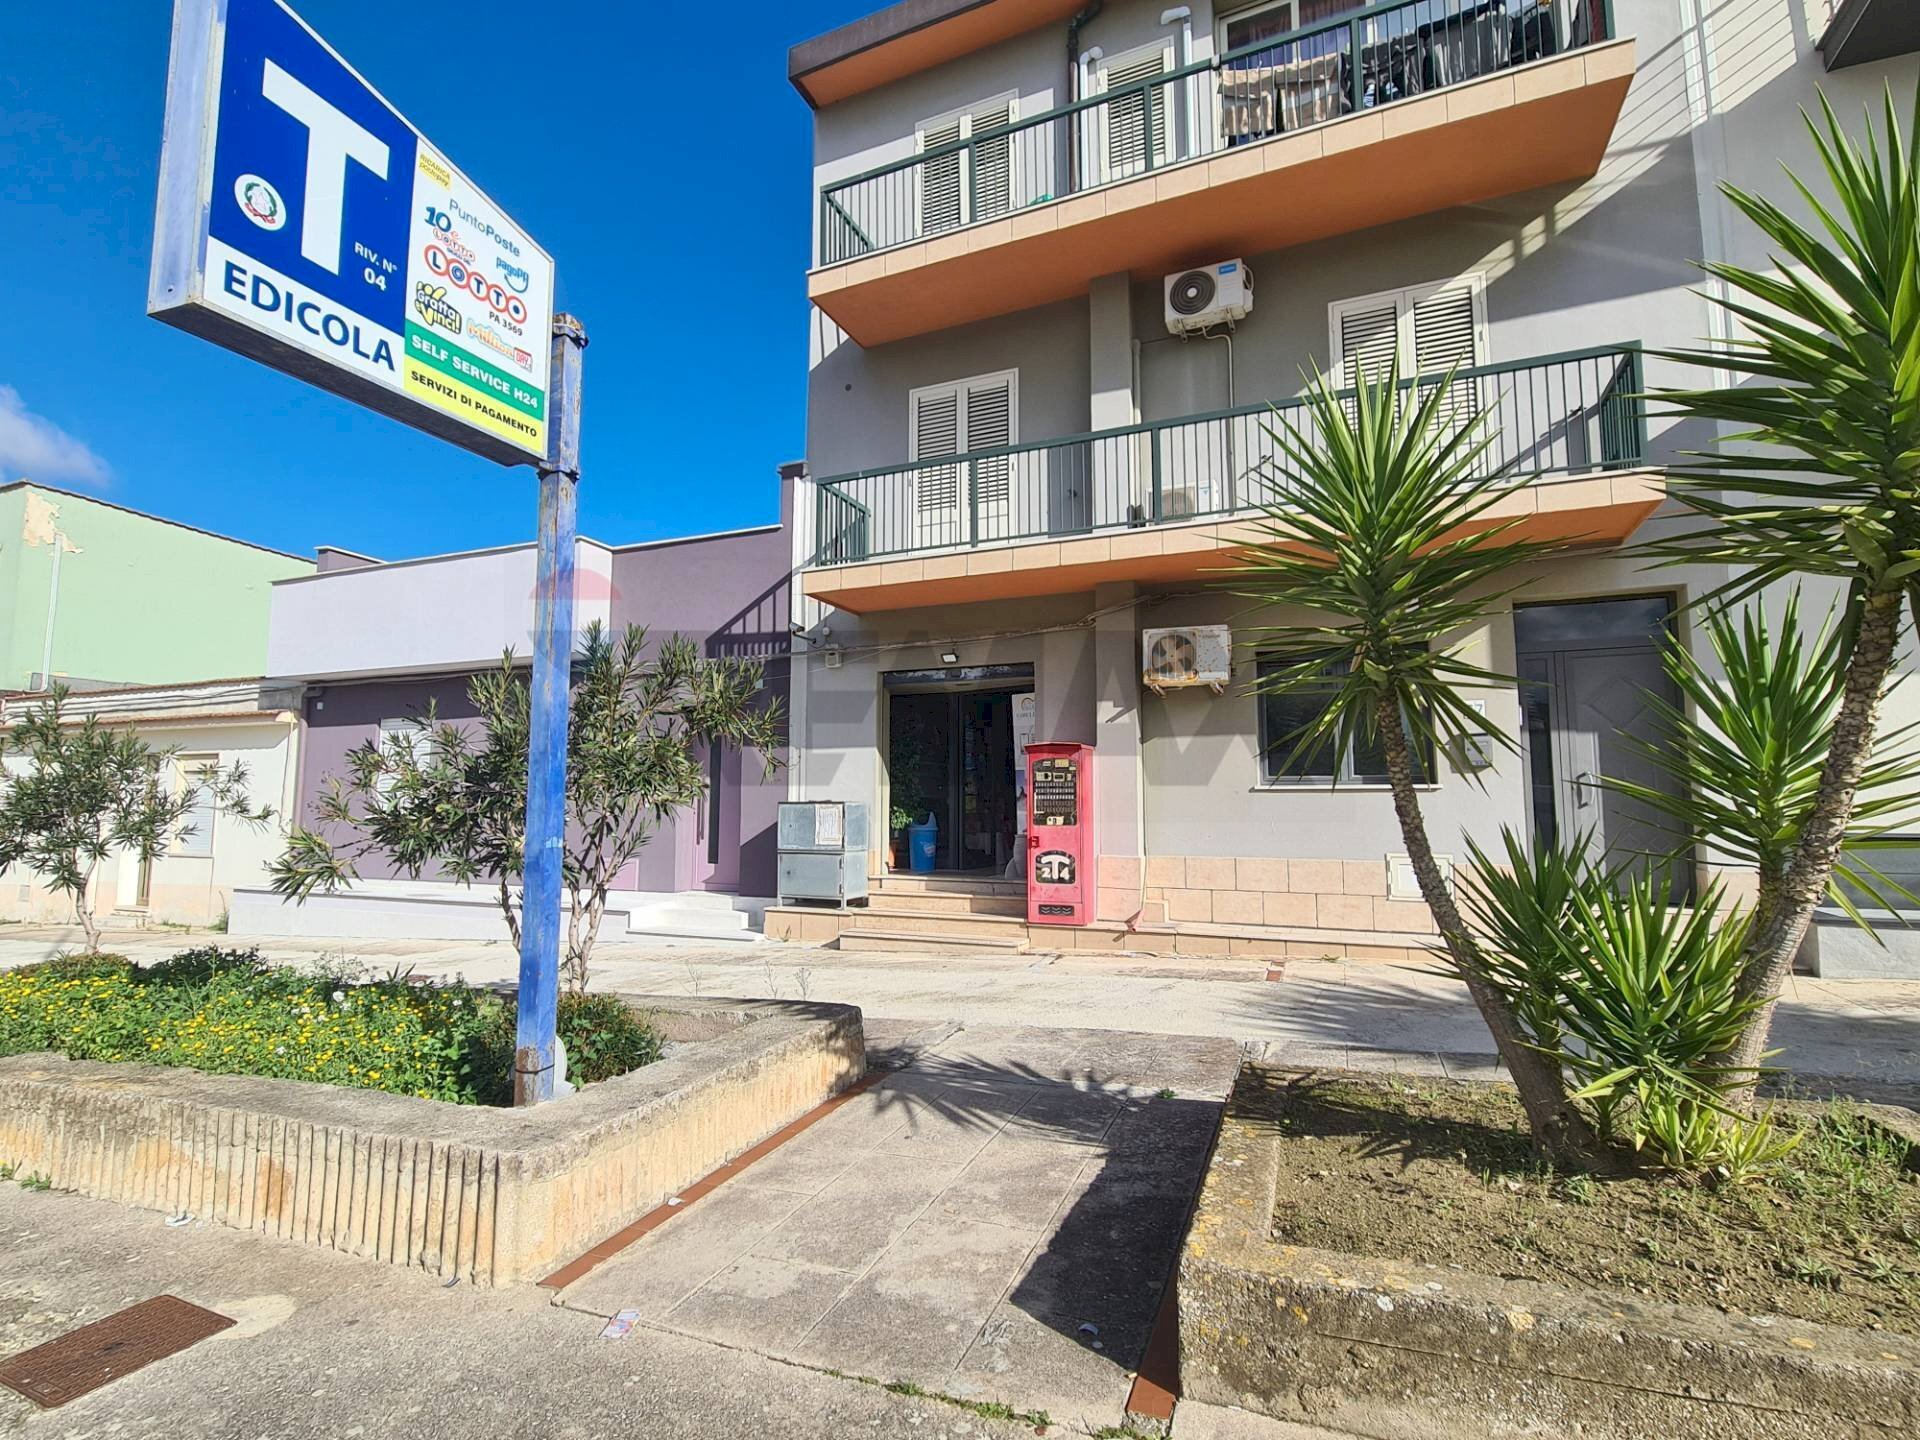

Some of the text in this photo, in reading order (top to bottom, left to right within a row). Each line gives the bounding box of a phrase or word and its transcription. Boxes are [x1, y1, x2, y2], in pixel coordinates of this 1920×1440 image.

[262, 57, 390, 276] T
[420, 153, 450, 180] RICARICA
[424, 206, 452, 232] 10
[449, 198, 521, 257] PuntoPoste
[355, 241, 379, 266] RIV.
[363, 267, 387, 291] 04
[424, 244, 527, 324] LOTTO
[223, 260, 395, 372] EDICOLA
[417, 289, 457, 320] Gratta
[489, 311, 523, 336] PA 3569
[411, 334, 538, 409] SELF SERVICE H24
[411, 370, 537, 438] SERVIZI DI PAGAMENTO
